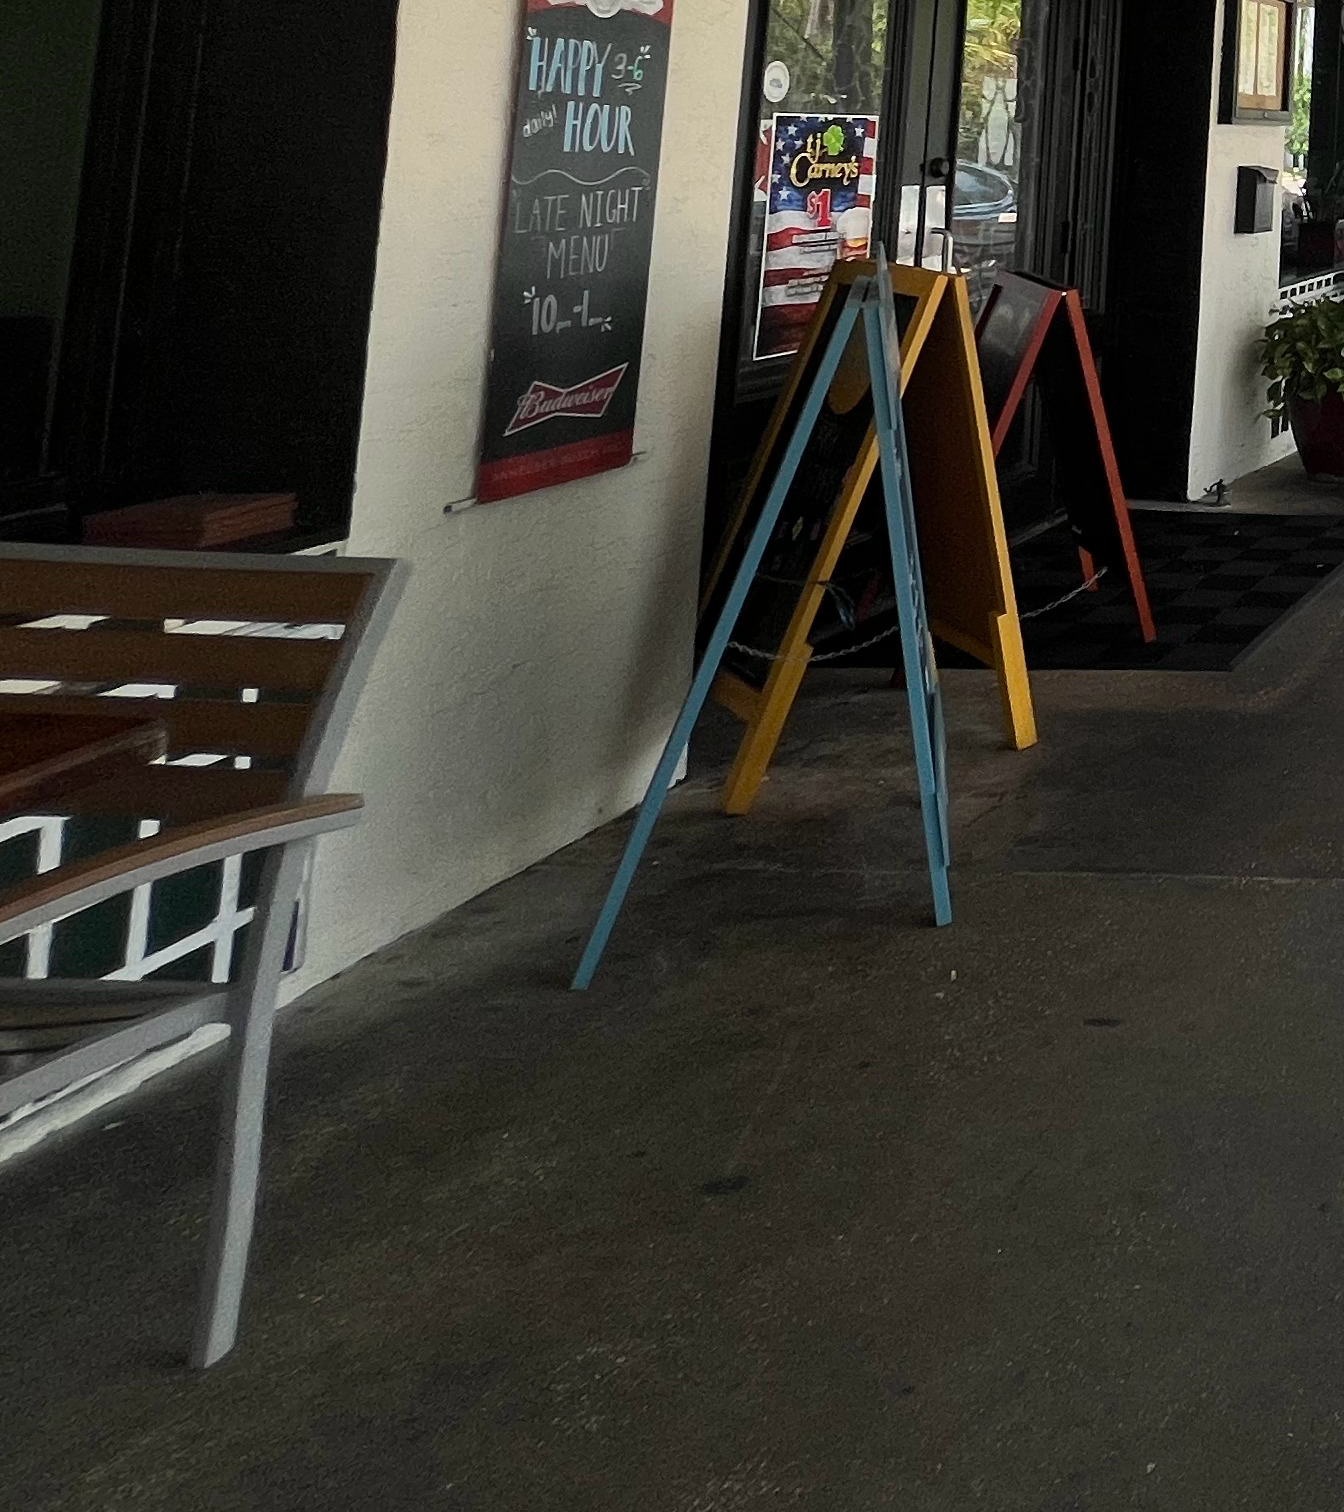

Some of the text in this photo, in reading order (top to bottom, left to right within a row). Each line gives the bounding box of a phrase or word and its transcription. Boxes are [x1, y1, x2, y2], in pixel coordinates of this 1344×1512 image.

[528, 36, 613, 98] HAPPY
[562, 100, 635, 157] HOUR
[789, 152, 859, 188] Carney's
[514, 186, 643, 234] LATE NIGHT
[546, 233, 609, 280] MENU
[516, 385, 615, 420] Budweiser
